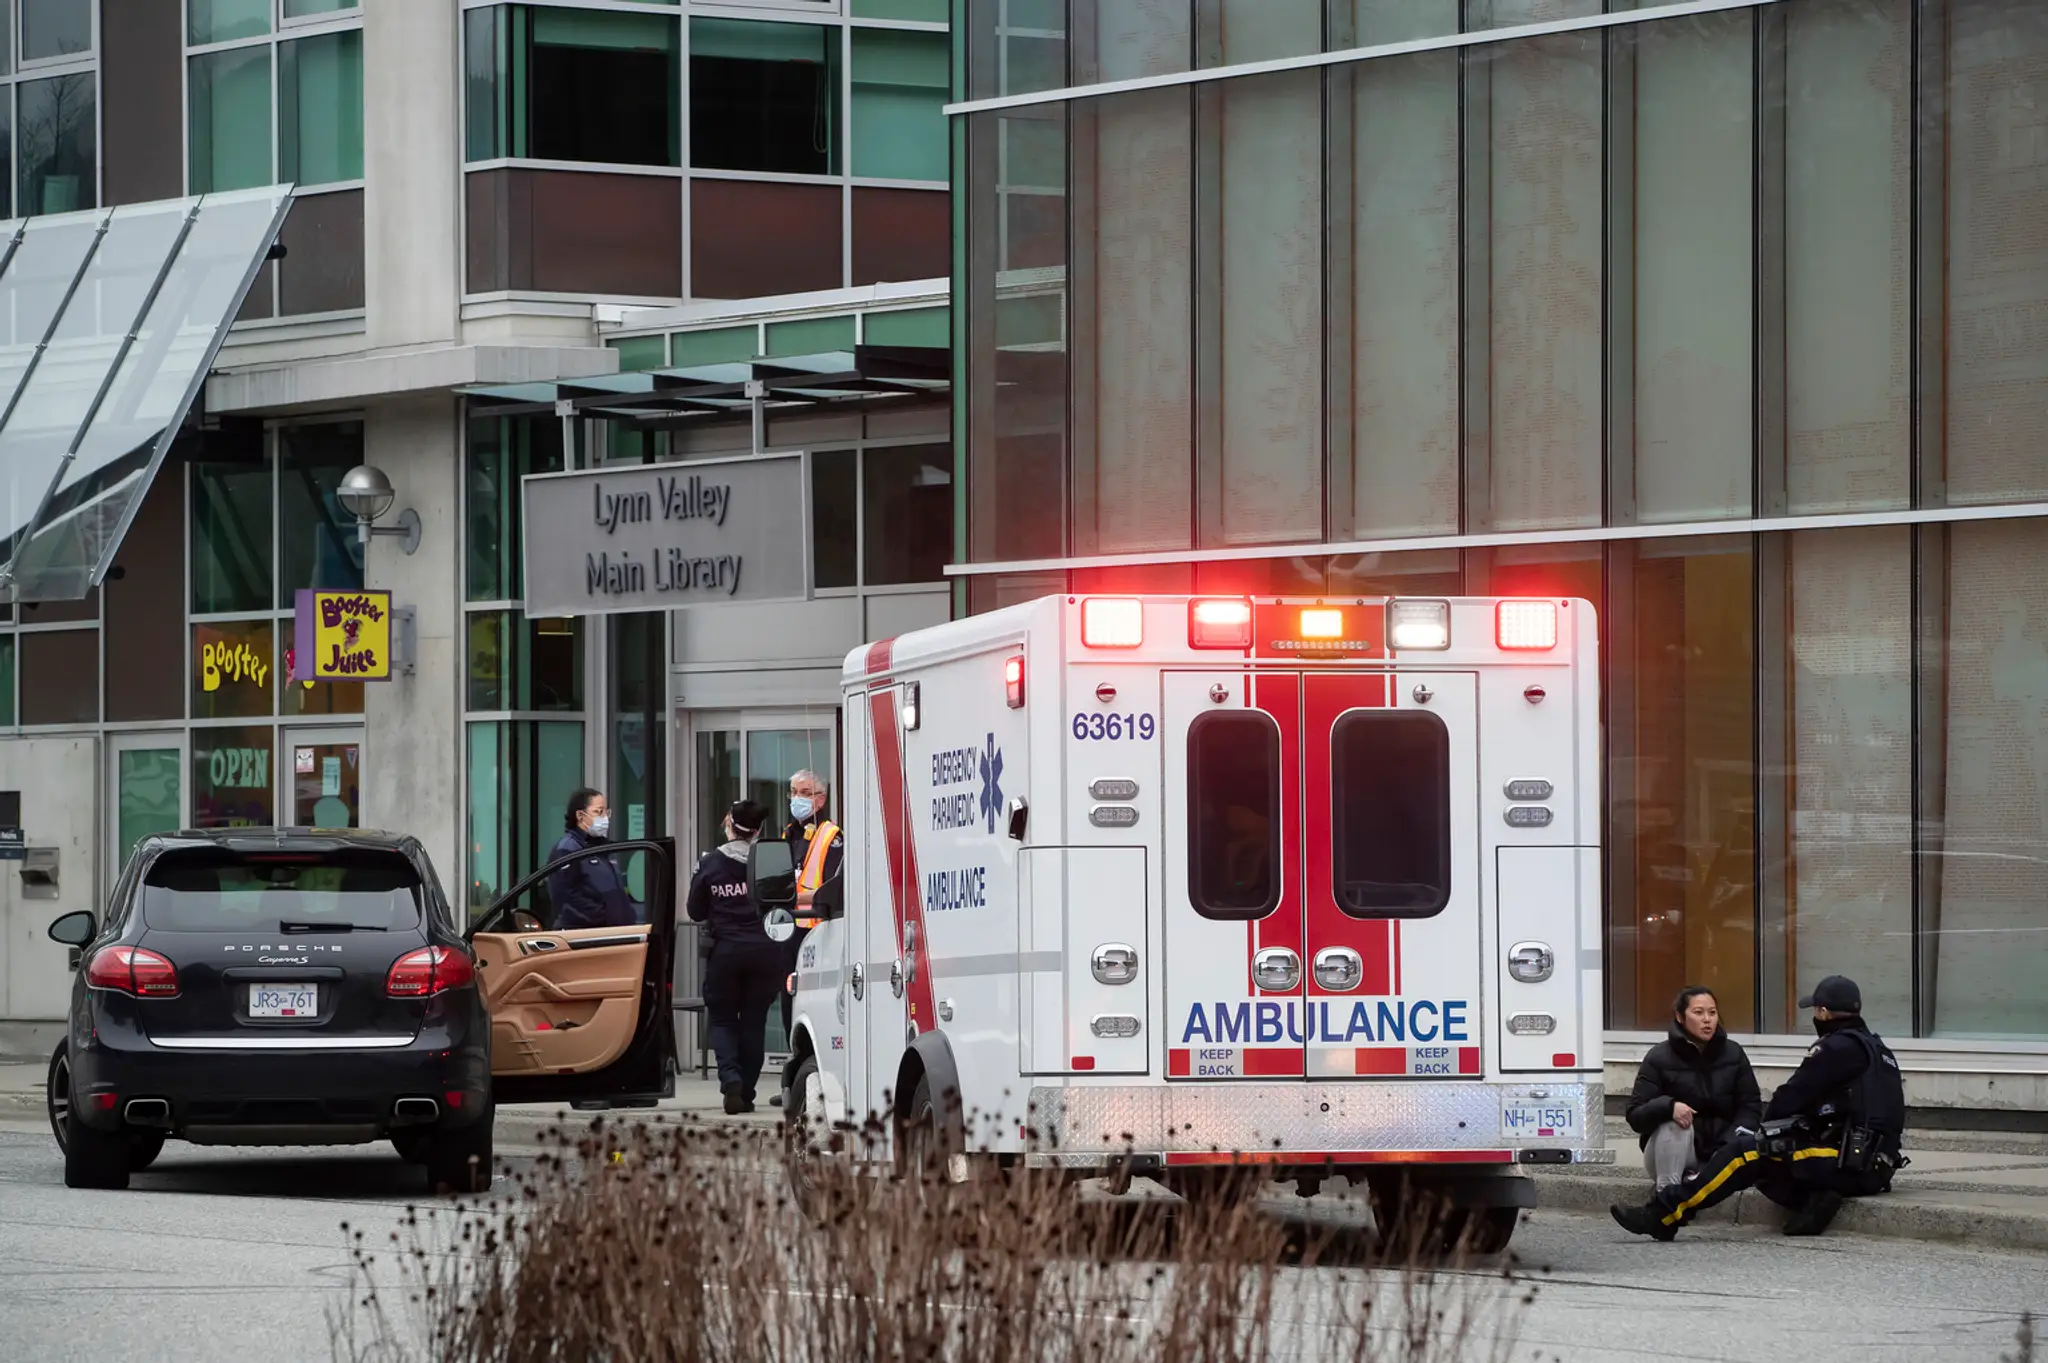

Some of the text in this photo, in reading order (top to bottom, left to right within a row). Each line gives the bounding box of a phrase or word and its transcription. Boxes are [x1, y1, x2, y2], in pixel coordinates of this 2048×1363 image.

[594, 476, 731, 535] Lynn Valley
[586, 548, 743, 596] Main Library
[320, 595, 384, 628] Booster
[203, 640, 267, 691] Booster
[323, 644, 377, 674] Juice
[1072, 712, 1155, 740] 63619
[210, 747, 269, 788] OPEN
[931, 746, 977, 787] EMERGENCY
[931, 791, 975, 831] PARAMEDIC
[926, 866, 985, 912] AMBULANCE
[1182, 1000, 1468, 1043] AMBULANCE
[1198, 1065, 1234, 1076] BACK
[1200, 1049, 1233, 1060] KEEP
[1415, 1063, 1450, 1074] BACK
[1416, 1047, 1449, 1058] KEEP
